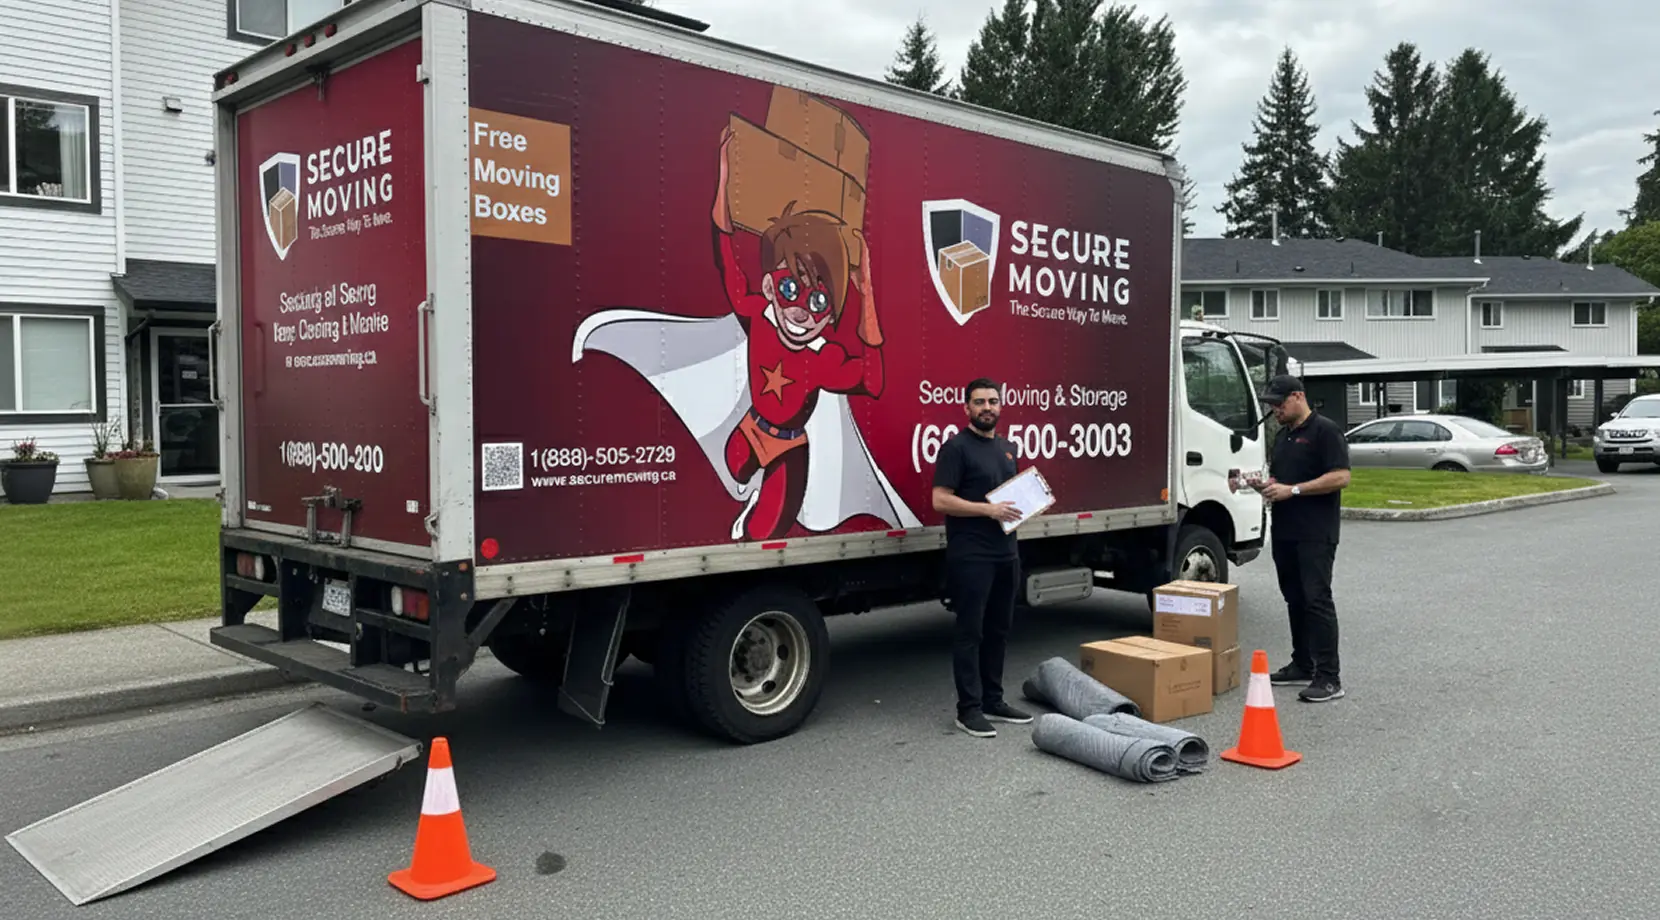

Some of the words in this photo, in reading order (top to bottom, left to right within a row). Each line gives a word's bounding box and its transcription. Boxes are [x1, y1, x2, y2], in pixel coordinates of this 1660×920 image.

[306, 128, 393, 185] SECURE
[474, 121, 528, 152] Free
[306, 172, 394, 221] MOVING
[474, 157, 561, 198] Moving
[474, 193, 549, 225] Boxes
[1010, 220, 1131, 271] SECURE
[1008, 262, 1131, 306] MOVING
[919, 379, 966, 405] Secu
[1054, 384, 1067, 407] &
[1069, 383, 1128, 412] Storage
[530, 445, 676, 472] 1(888)-505-2729
